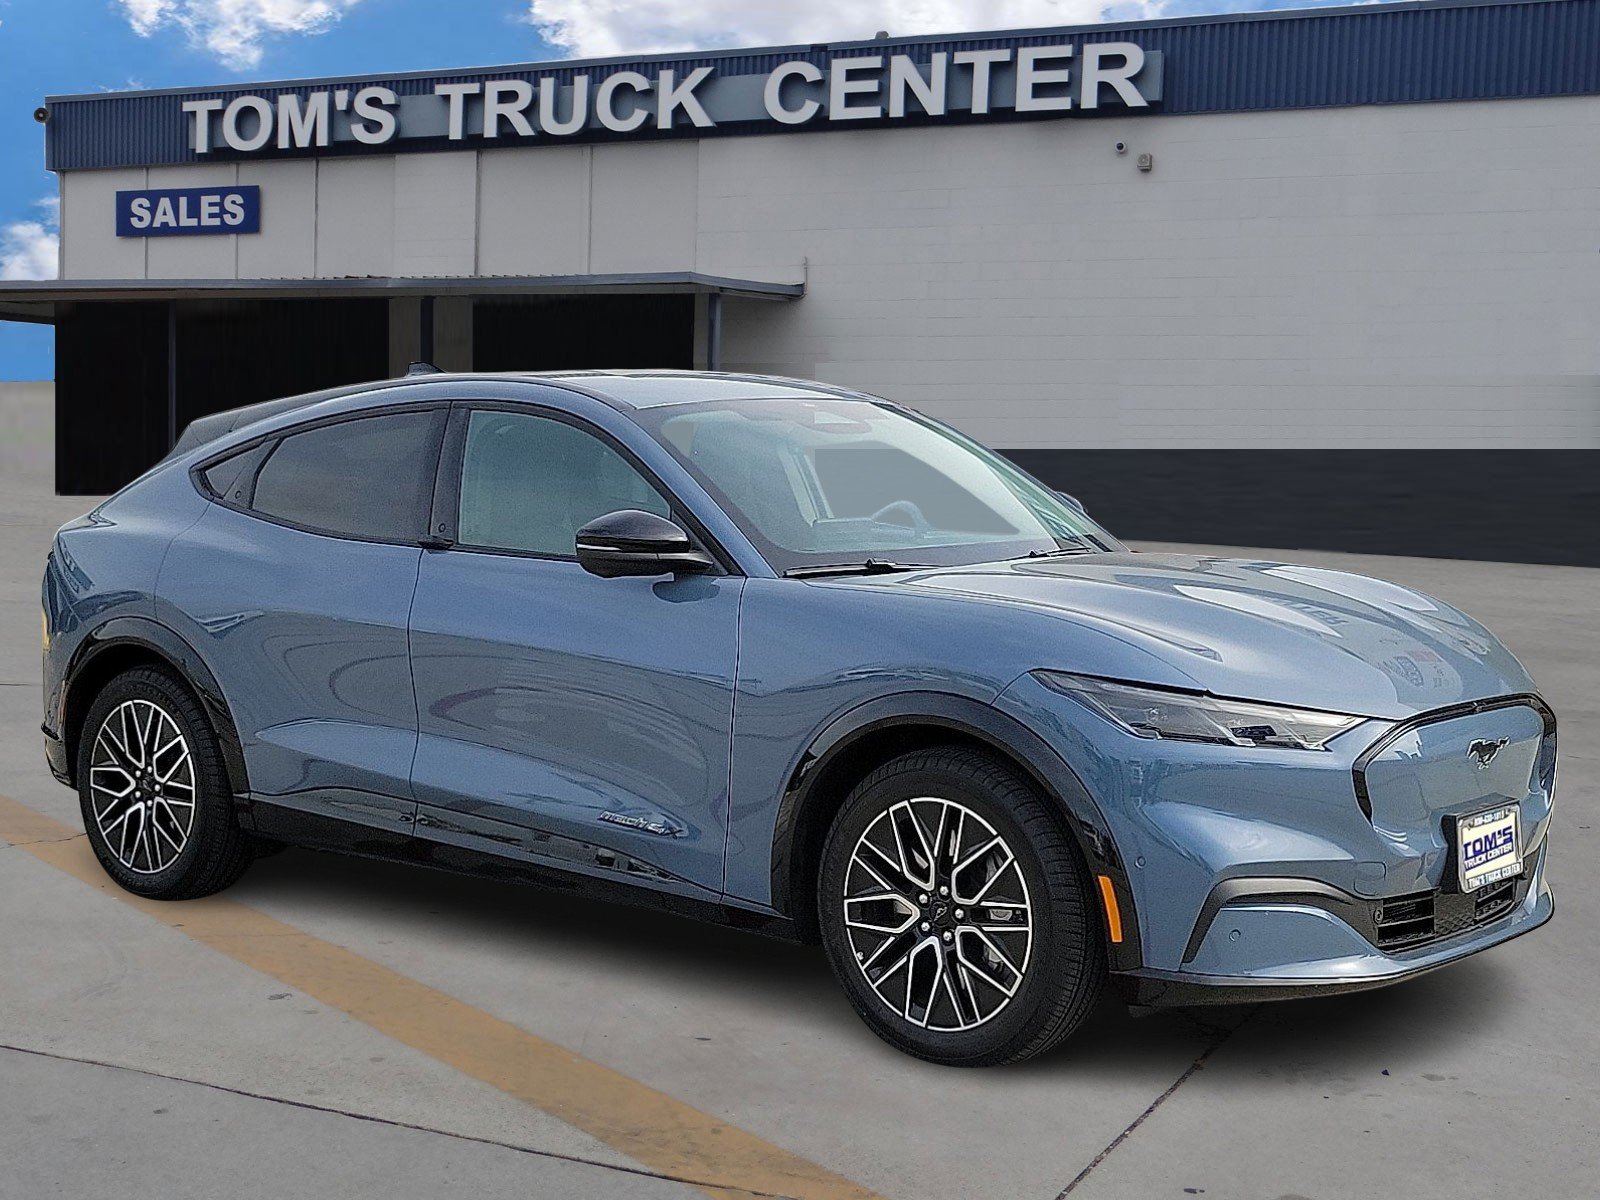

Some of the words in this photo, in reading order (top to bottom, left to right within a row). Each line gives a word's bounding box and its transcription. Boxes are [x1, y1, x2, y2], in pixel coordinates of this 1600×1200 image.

[182, 86, 400, 154] TOM'S
[434, 66, 716, 141] TRUCK
[763, 41, 1151, 125] CENTER
[129, 193, 246, 229] SALES
[1463, 826, 1514, 861] TOM'S
[1465, 853, 1487, 870] TRUCK
[1487, 844, 1513, 860] CENTER
